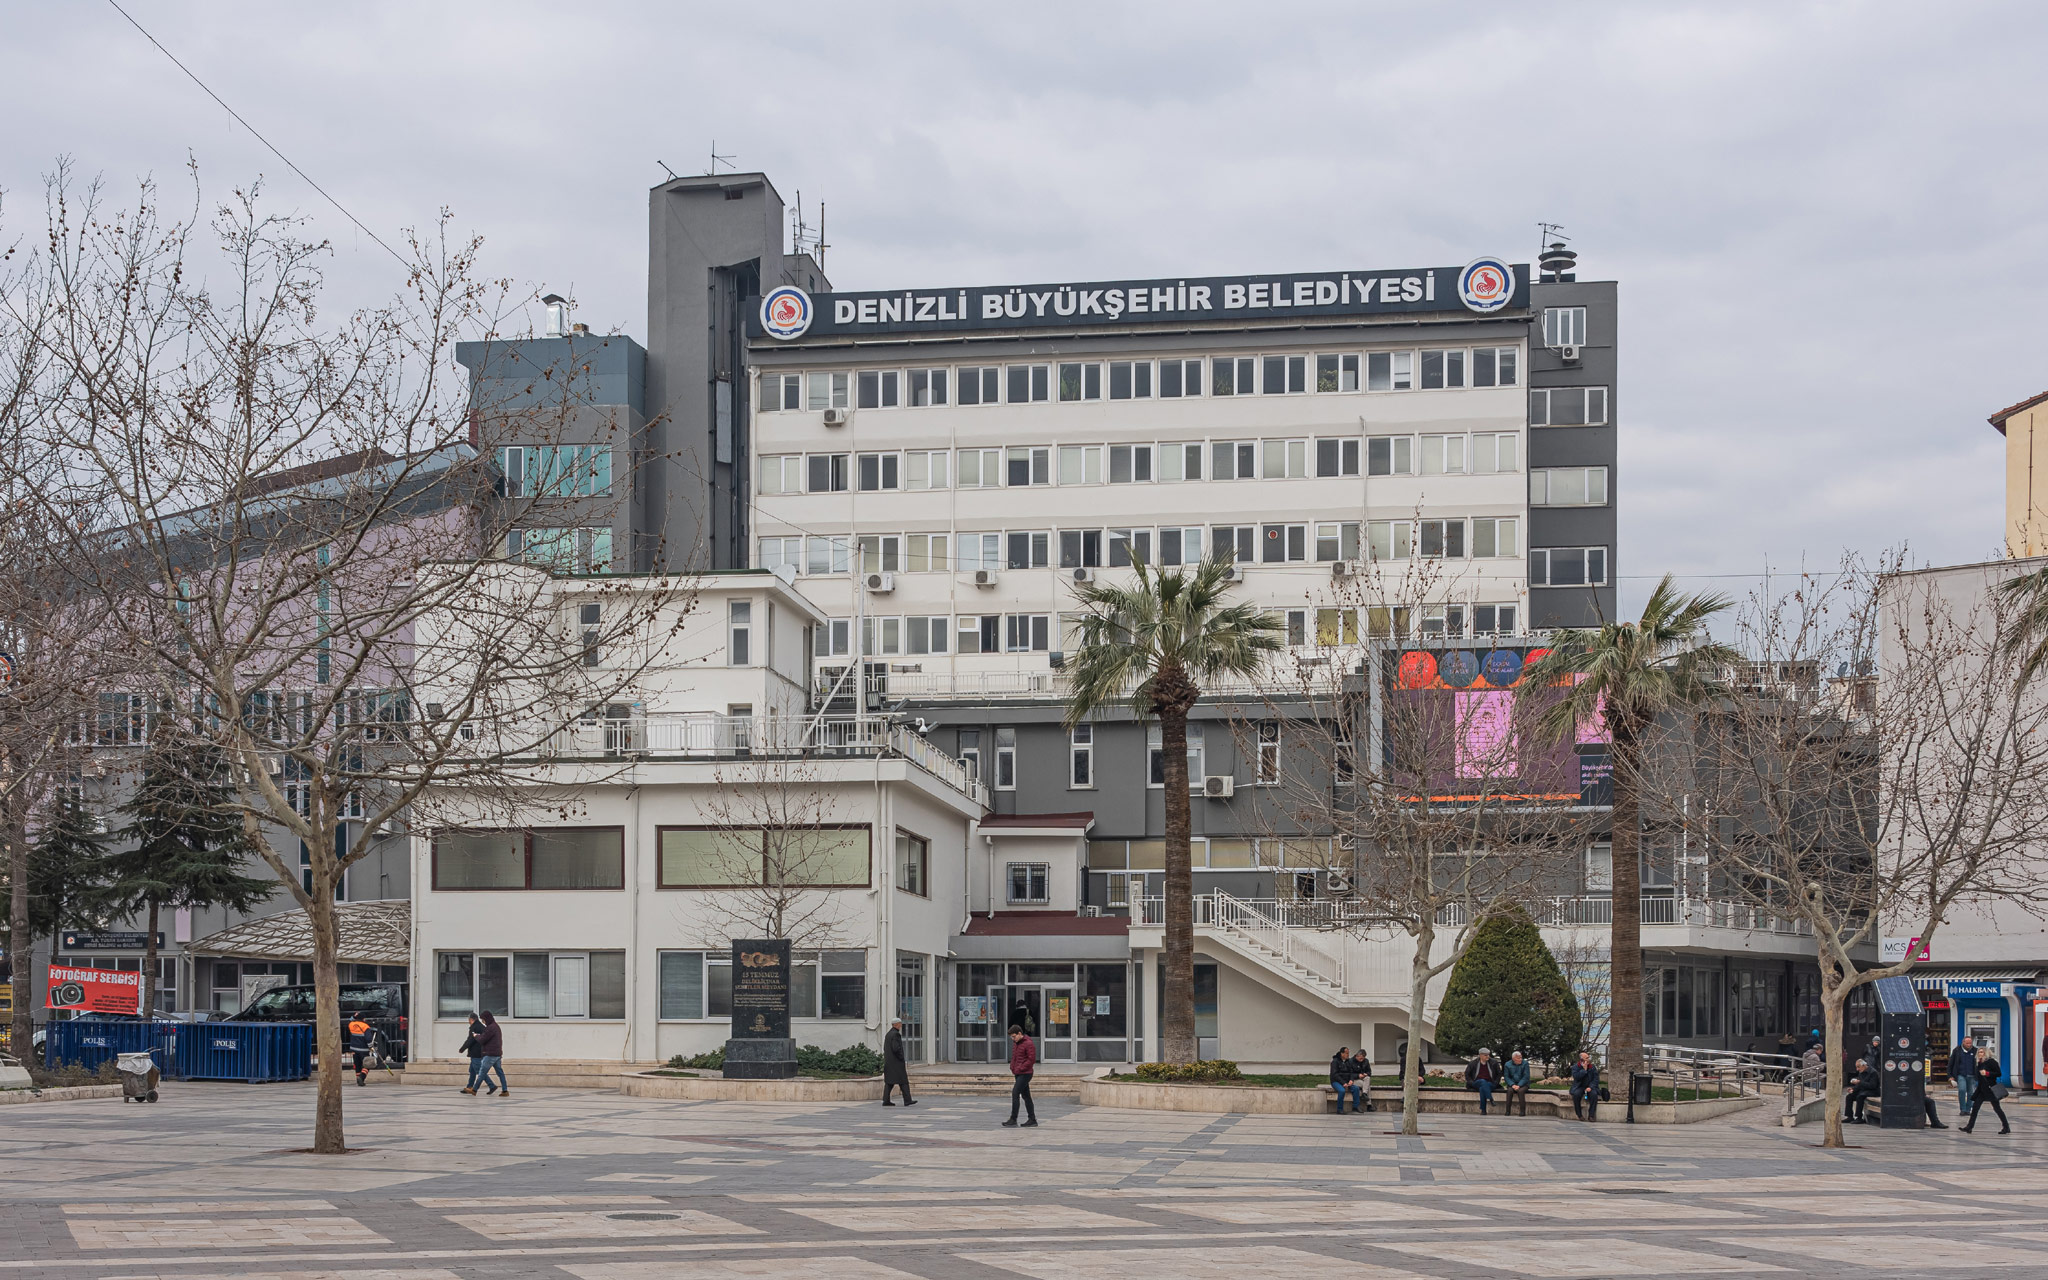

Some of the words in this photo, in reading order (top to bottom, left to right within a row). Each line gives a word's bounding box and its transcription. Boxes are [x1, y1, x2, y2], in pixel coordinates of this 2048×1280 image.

[834, 290, 967, 324] DENİZLİ
[982, 281, 1213, 320] BÜYÜKŞEHİR
[1224, 270, 1435, 309] BELEDİYESİ
[1884, 942, 1906, 952] MCS
[50, 968, 98, 982] FOTOĞRAF
[99, 972, 138, 986] SERGİSİ
[1958, 986, 1998, 994] HALKBANK
